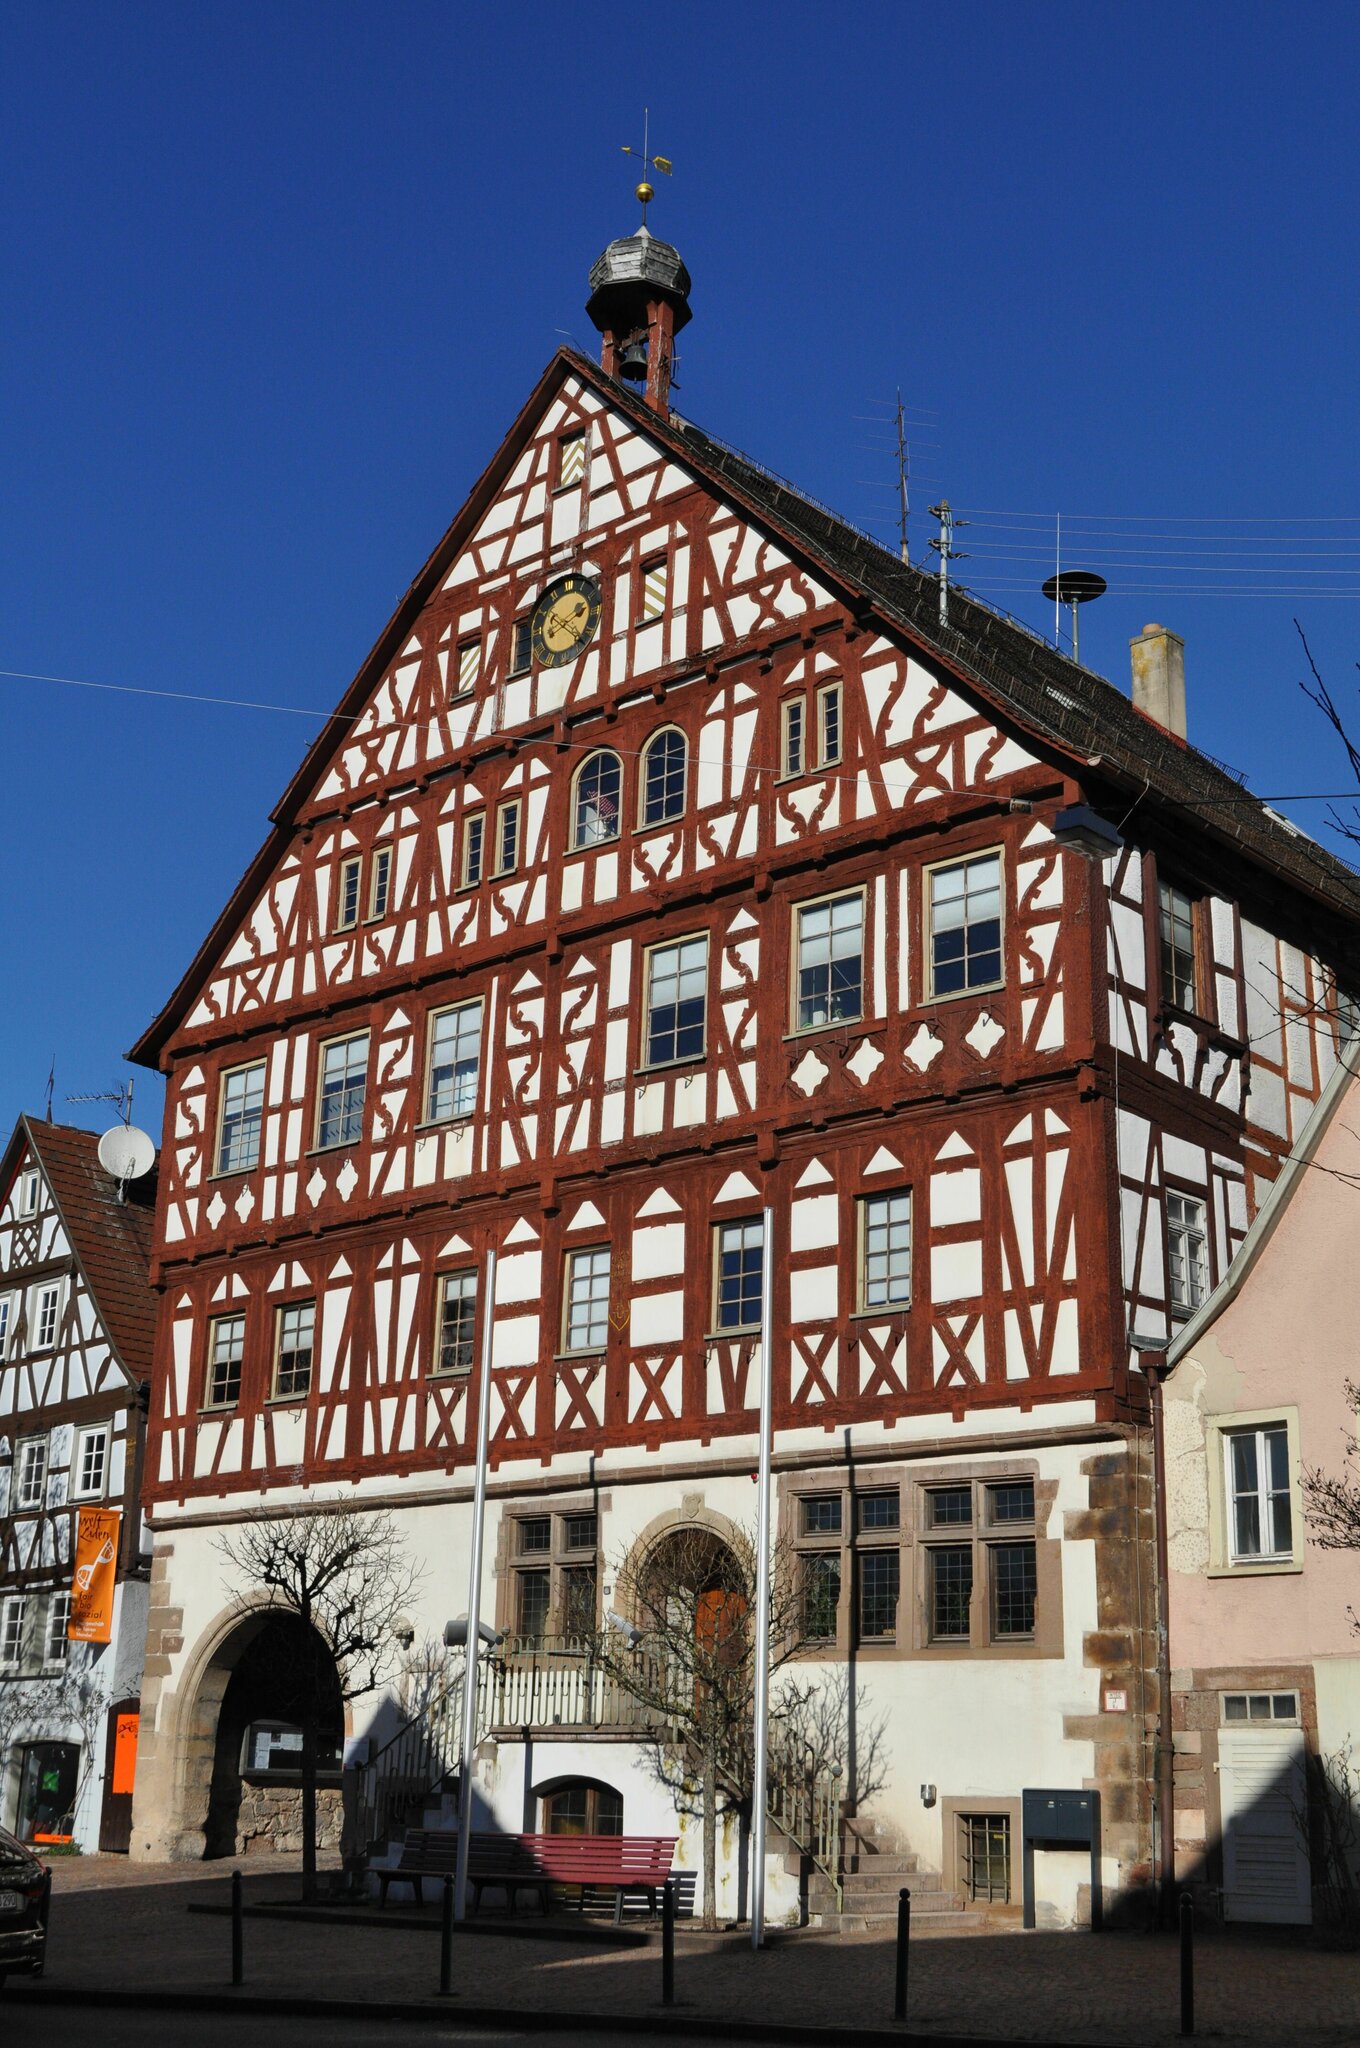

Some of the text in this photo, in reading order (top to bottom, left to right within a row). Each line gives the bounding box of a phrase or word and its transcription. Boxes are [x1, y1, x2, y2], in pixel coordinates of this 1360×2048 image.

[79, 1512, 116, 1529] welt
[79, 1590, 93, 1600] fair
[79, 1600, 92, 1609] bio
